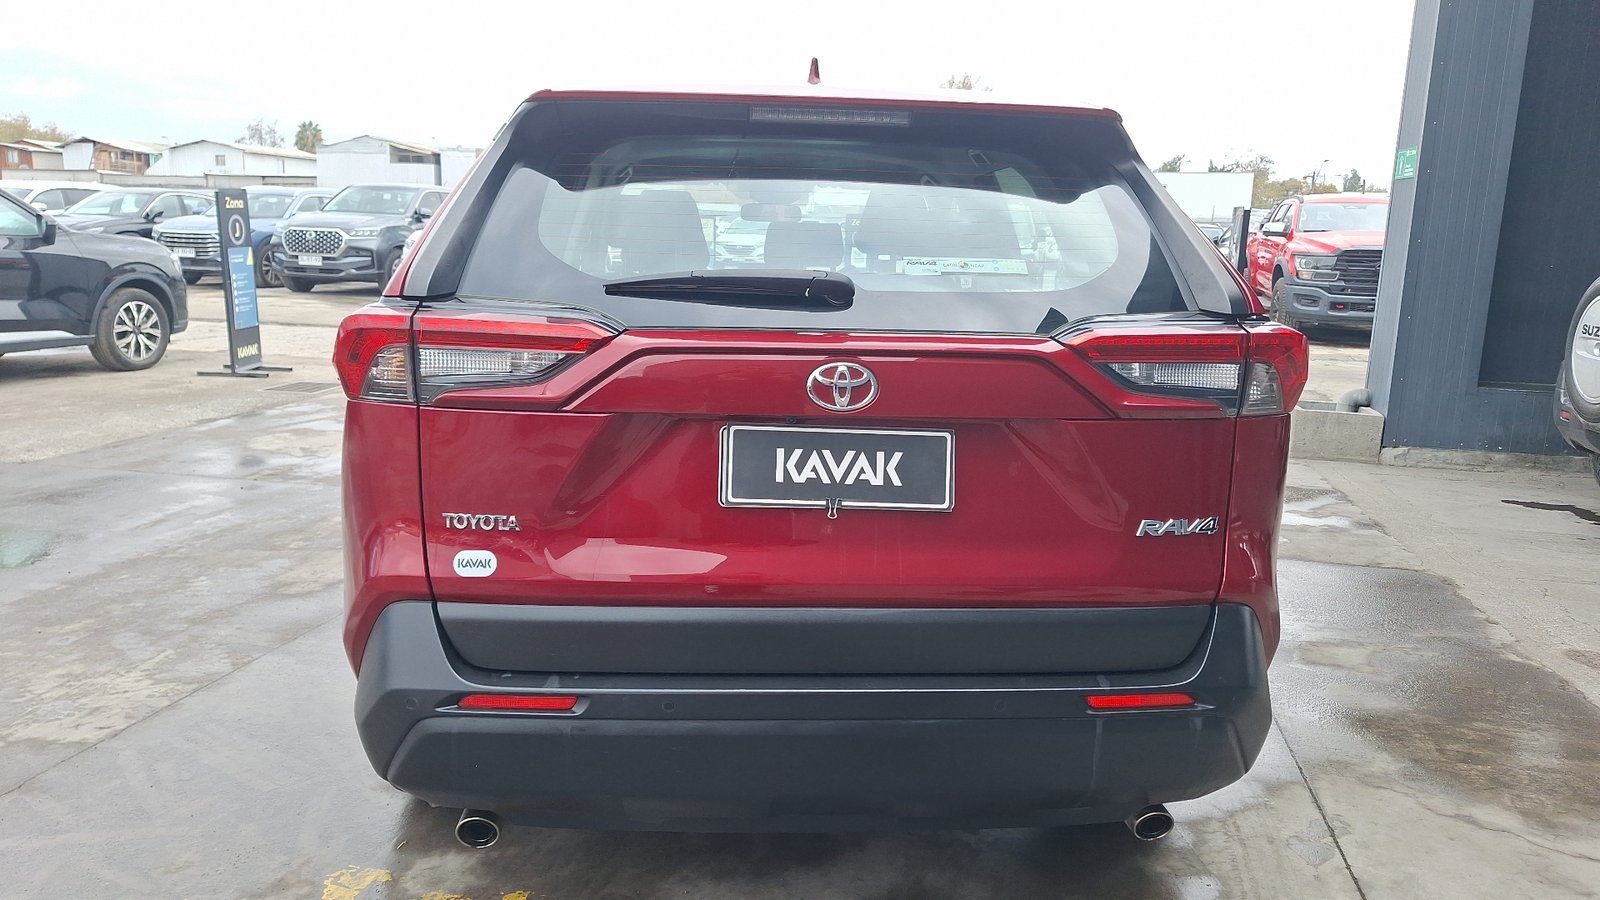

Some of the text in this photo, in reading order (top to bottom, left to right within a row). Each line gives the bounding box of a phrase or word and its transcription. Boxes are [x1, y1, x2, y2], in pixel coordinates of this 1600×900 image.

[225, 196, 244, 209] Zona
[237, 343, 259, 359] KAVAK
[776, 447, 903, 486] KAVAK
[442, 512, 520, 531] TOYOTA
[1136, 516, 1219, 536] RAV4
[457, 558, 492, 569] KAVAK
